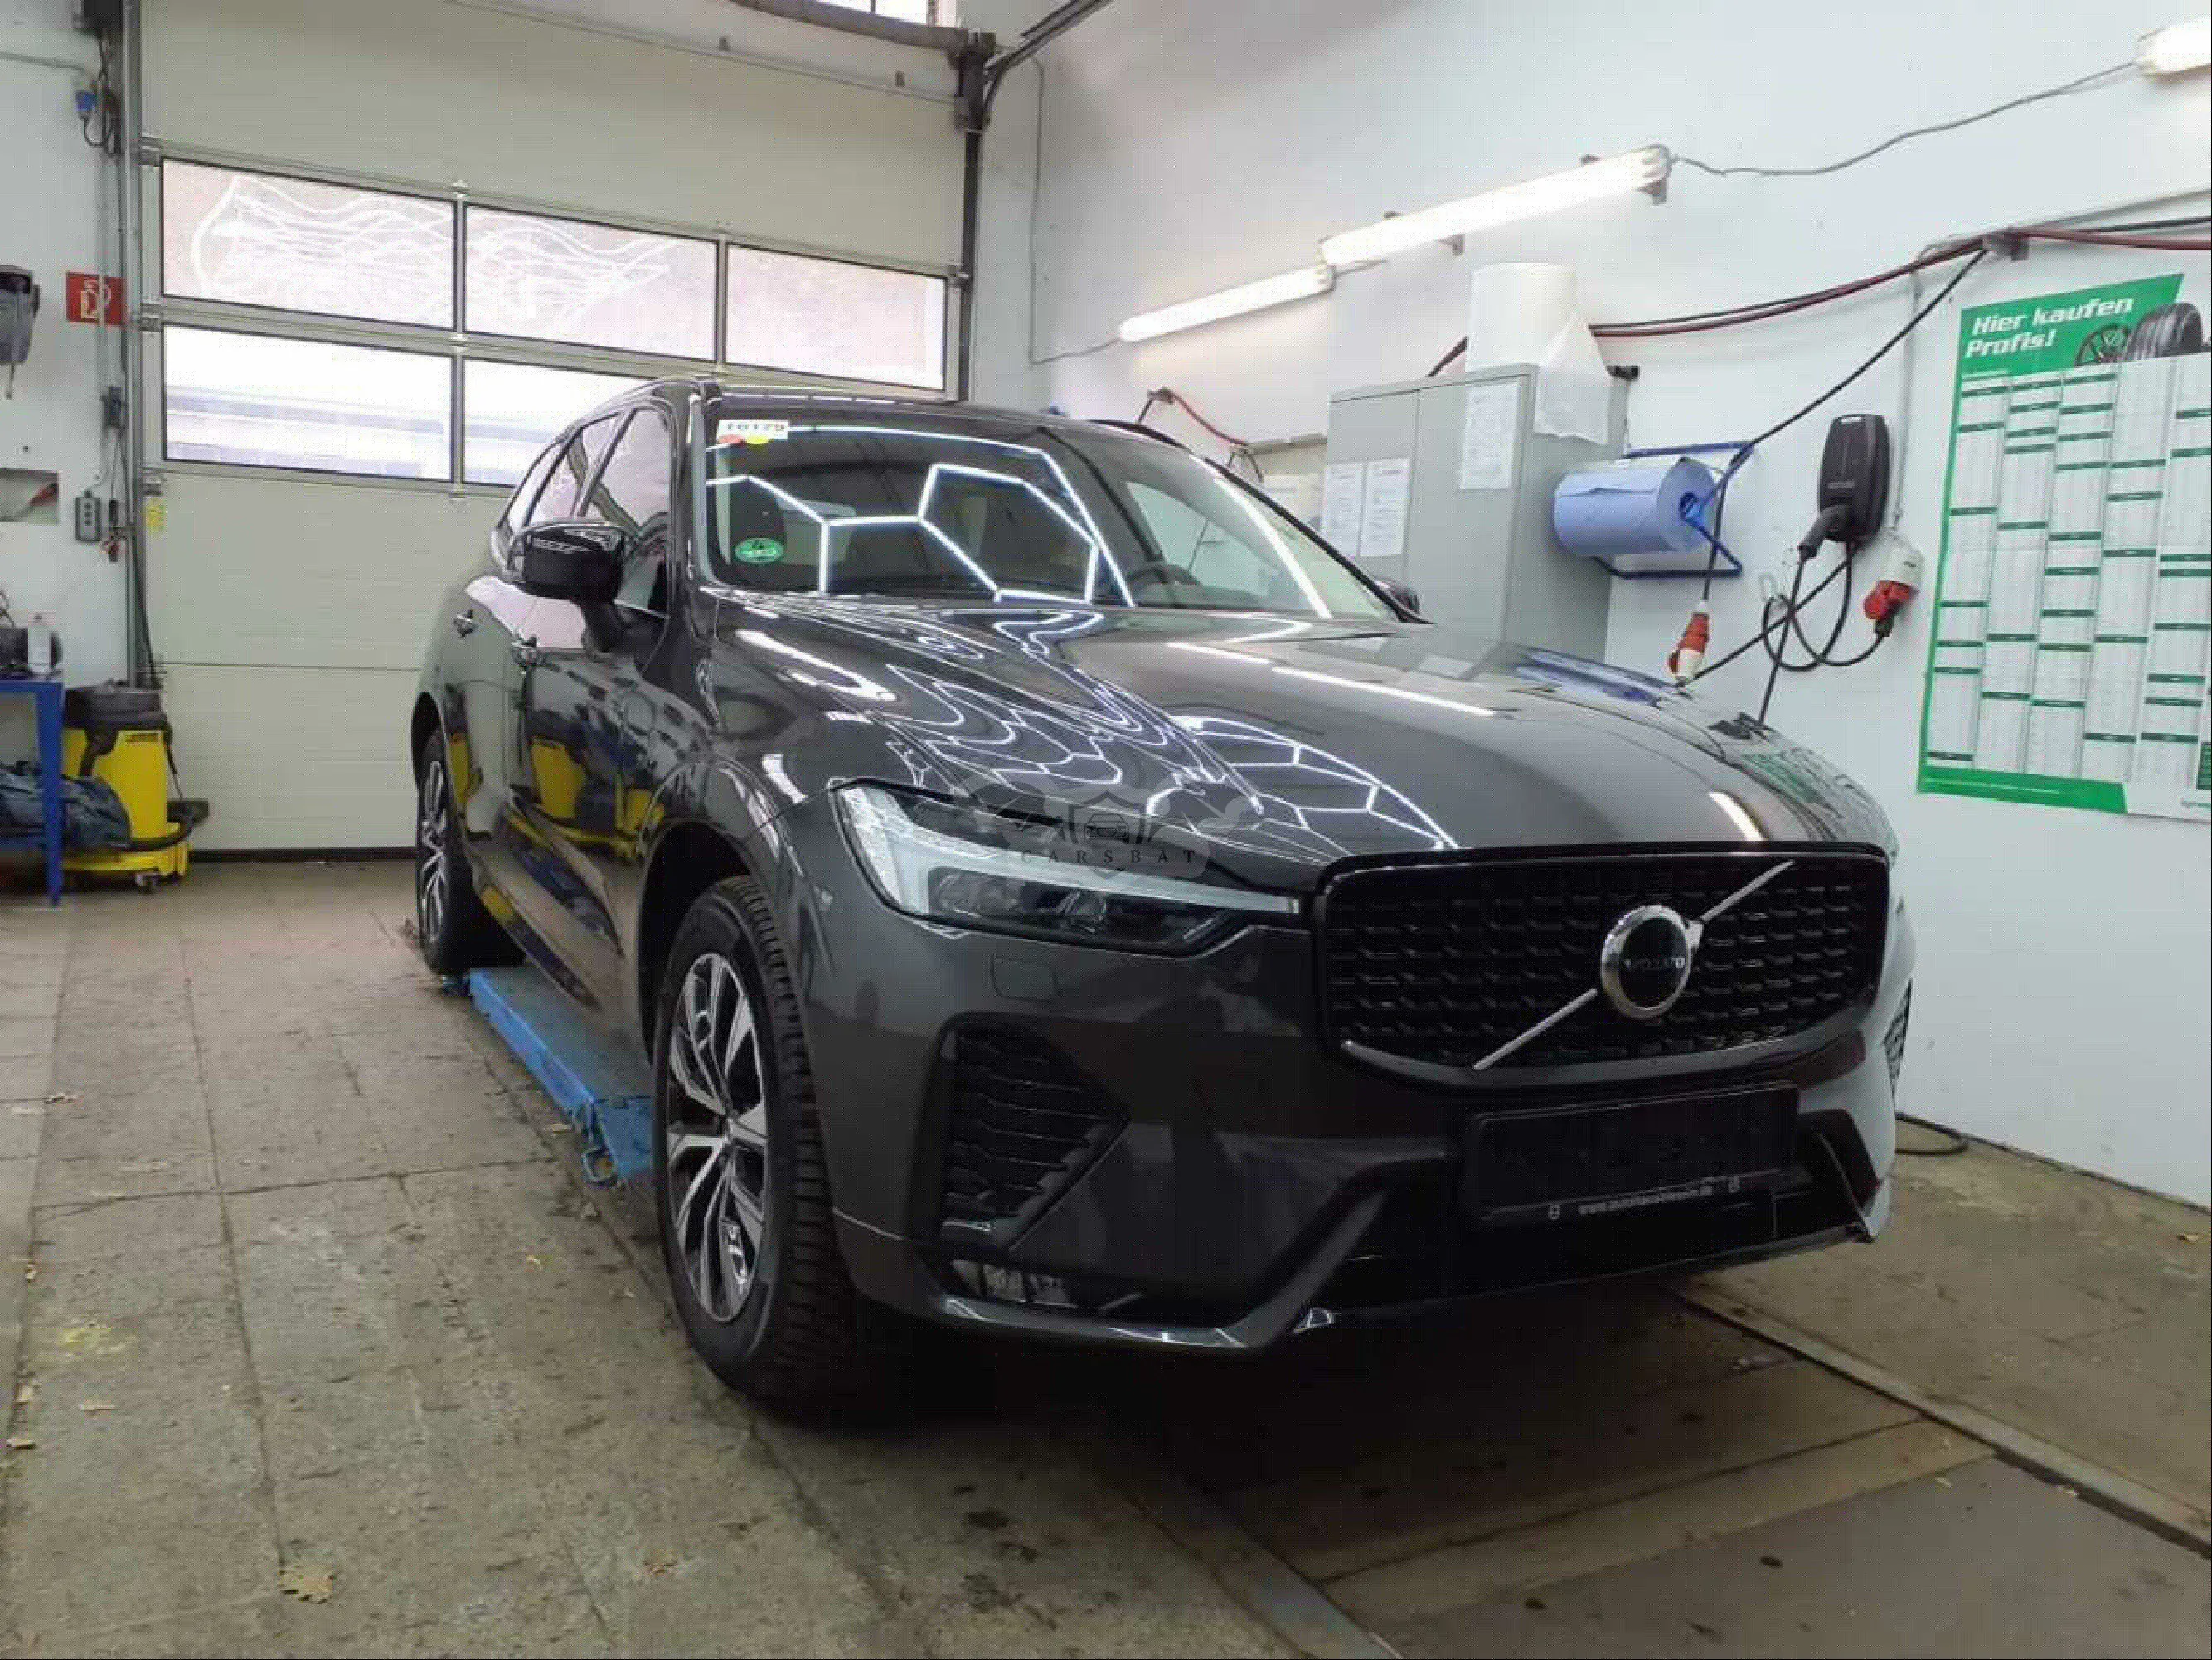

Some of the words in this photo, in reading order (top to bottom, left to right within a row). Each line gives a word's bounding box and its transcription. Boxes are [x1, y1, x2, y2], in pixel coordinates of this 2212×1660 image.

[1972, 314, 2027, 335] Hier
[2032, 298, 2135, 327] kaufen
[1966, 330, 2058, 357] Profis!
